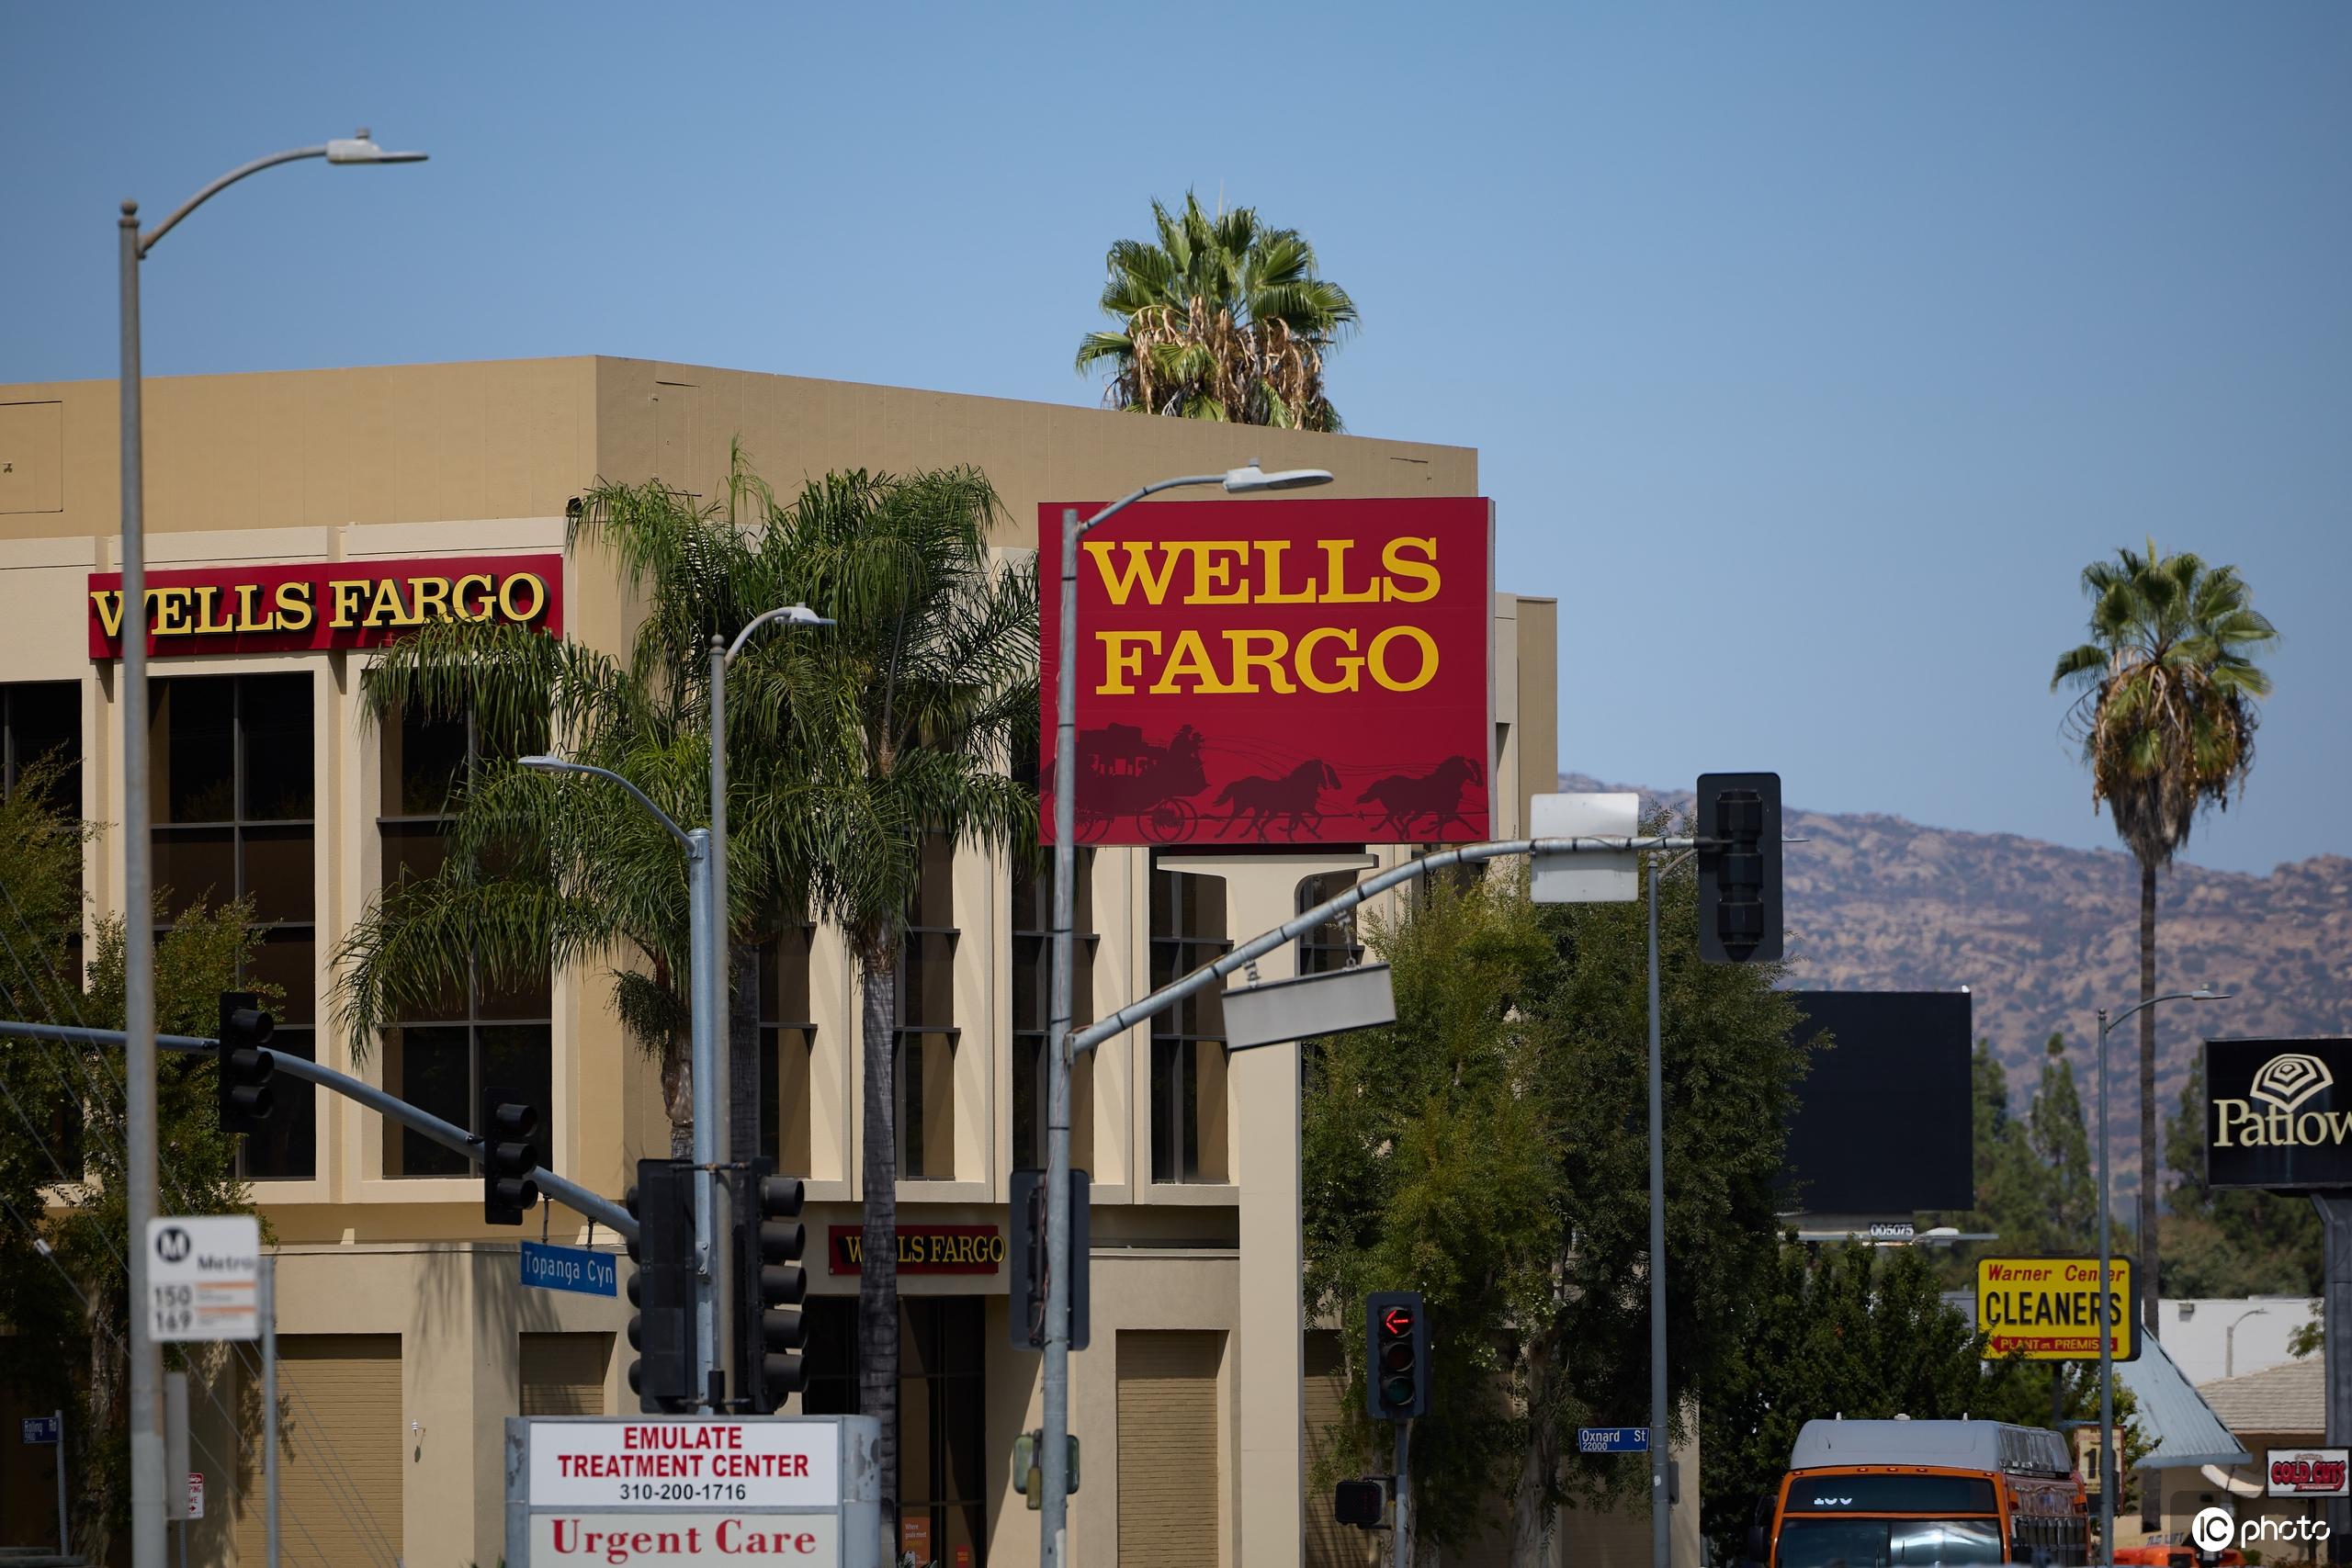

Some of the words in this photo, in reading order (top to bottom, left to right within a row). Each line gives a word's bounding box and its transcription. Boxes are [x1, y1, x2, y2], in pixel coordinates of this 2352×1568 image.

[1083, 536, 1442, 605] WELLS
[90, 581, 314, 637] WELLS
[329, 572, 545, 628] FARGO
[1095, 626, 1440, 694] FARGO
[845, 1235, 924, 1263] WLS
[930, 1235, 1006, 1263] FARGO
[525, 1251, 580, 1285] Topanga
[588, 1259, 613, 1288] Cyn
[1988, 1264, 2052, 1281] Warner
[2065, 1264, 2125, 1281] Cener
[156, 1285, 192, 1306] 150
[1986, 1292, 2121, 1325] CLEANERS
[623, 1427, 742, 1450] EMULATE
[1582, 1429, 1620, 1442] Oxnard
[1634, 1429, 1646, 1442] St
[1582, 1442, 1608, 1450] 22000
[557, 1455, 704, 1477] TREATMENT
[712, 1455, 808, 1477] CENTER
[2271, 1461, 2311, 1485] COLD
[2312, 1461, 2346, 1486] CUTS
[619, 1483, 746, 1500] 310-200-1716
[551, 1518, 702, 1564] Urgent
[716, 1518, 817, 1554] Care
